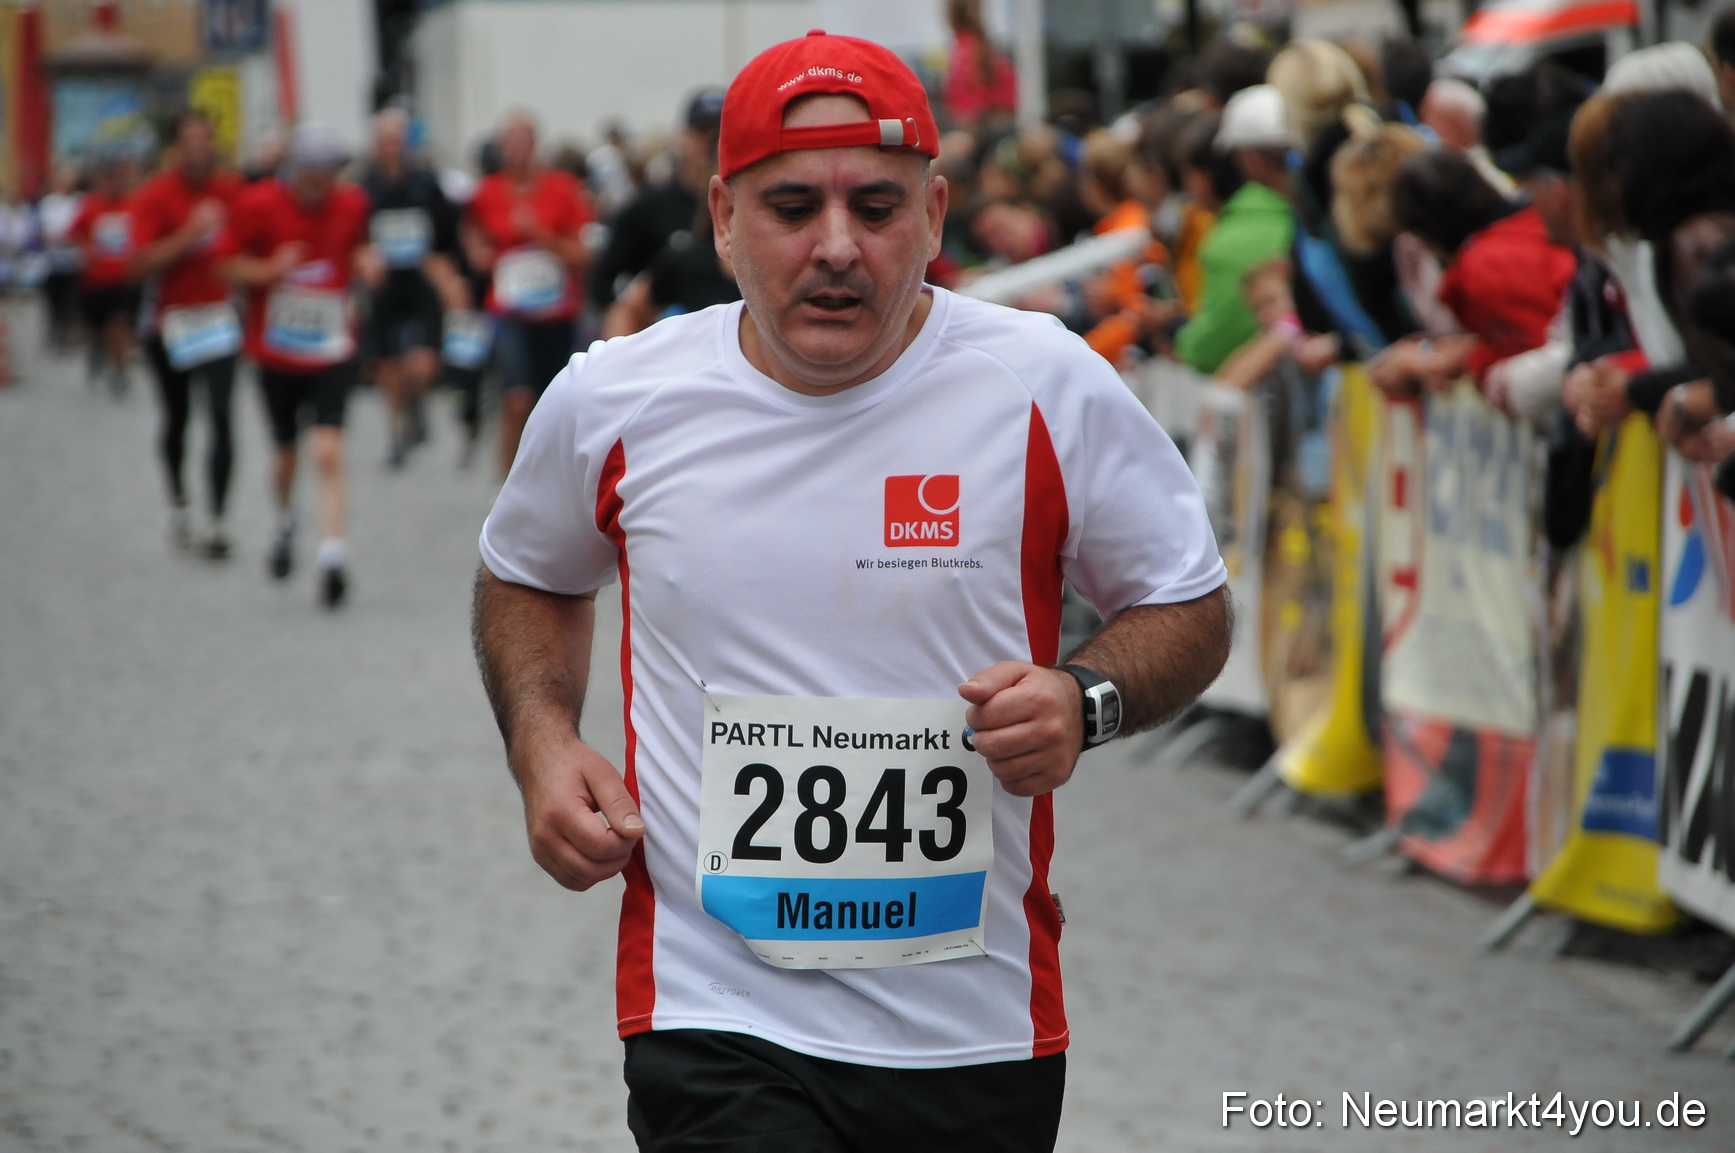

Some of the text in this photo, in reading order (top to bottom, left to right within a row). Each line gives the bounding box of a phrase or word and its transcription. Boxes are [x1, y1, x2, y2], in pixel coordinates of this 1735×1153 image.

[777, 66, 863, 92] www.dkms.de
[890, 521, 954, 540] DKMS
[855, 557, 984, 570] Wir besiegen Blutkrebs.
[710, 721, 951, 751] PARTL Neumarkt
[731, 762, 968, 864] 2843
[710, 854, 721, 871] D
[776, 891, 917, 930] Manuel
